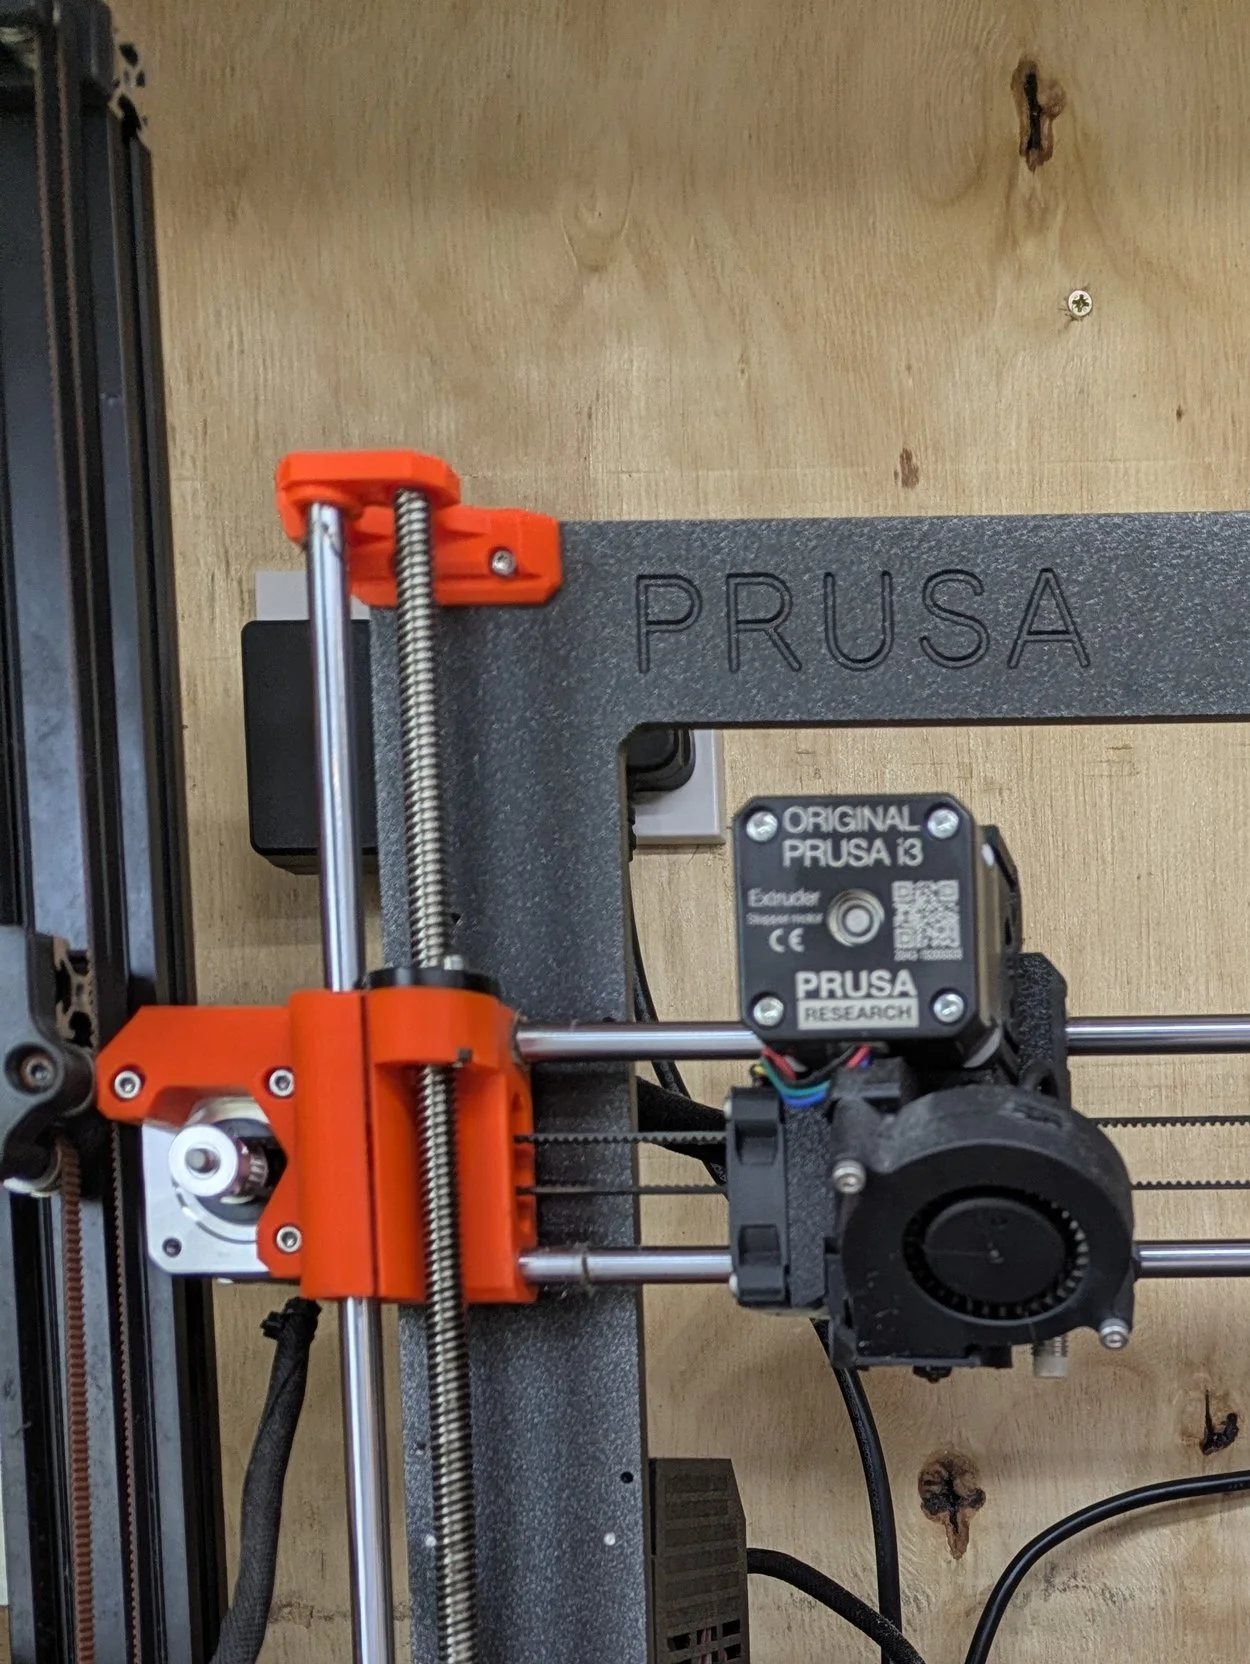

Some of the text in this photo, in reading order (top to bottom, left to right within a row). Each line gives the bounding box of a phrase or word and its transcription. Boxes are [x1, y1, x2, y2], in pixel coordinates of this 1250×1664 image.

[636, 568, 1091, 674] PRUSA
[782, 804, 921, 834] ORIGINAL
[782, 837, 924, 868] PRUSA i3
[747, 886, 821, 908] Extruder
[794, 968, 918, 999] PRUSA
[804, 1004, 912, 1023] RESEARCH
